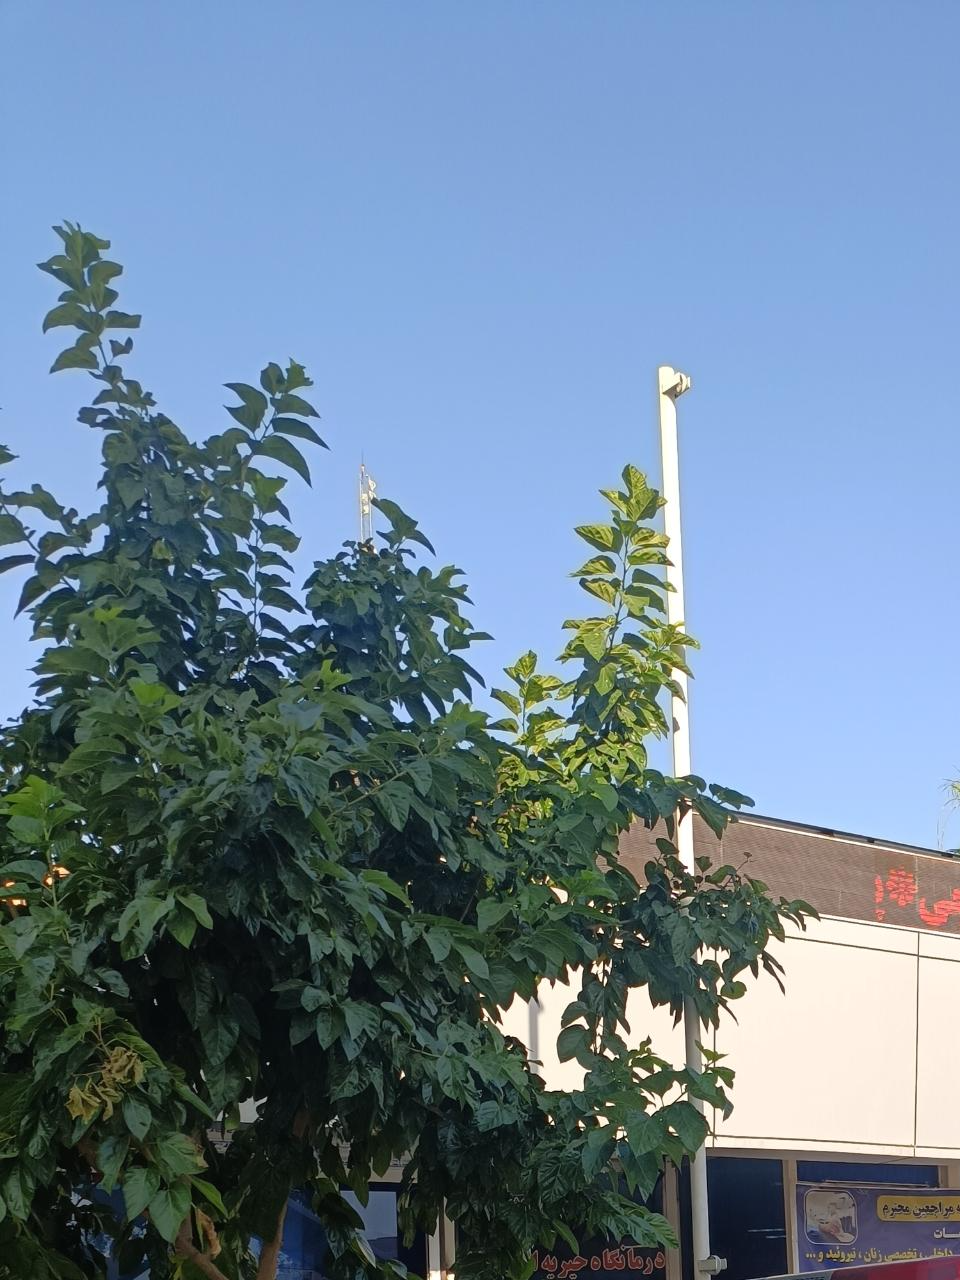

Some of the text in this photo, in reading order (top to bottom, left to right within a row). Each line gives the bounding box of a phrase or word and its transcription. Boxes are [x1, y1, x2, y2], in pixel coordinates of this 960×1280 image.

[882, 1203, 910, 1217] محترم
[912, 1202, 955, 1217] مراجعین
[863, 1247, 882, 1262] زنان
